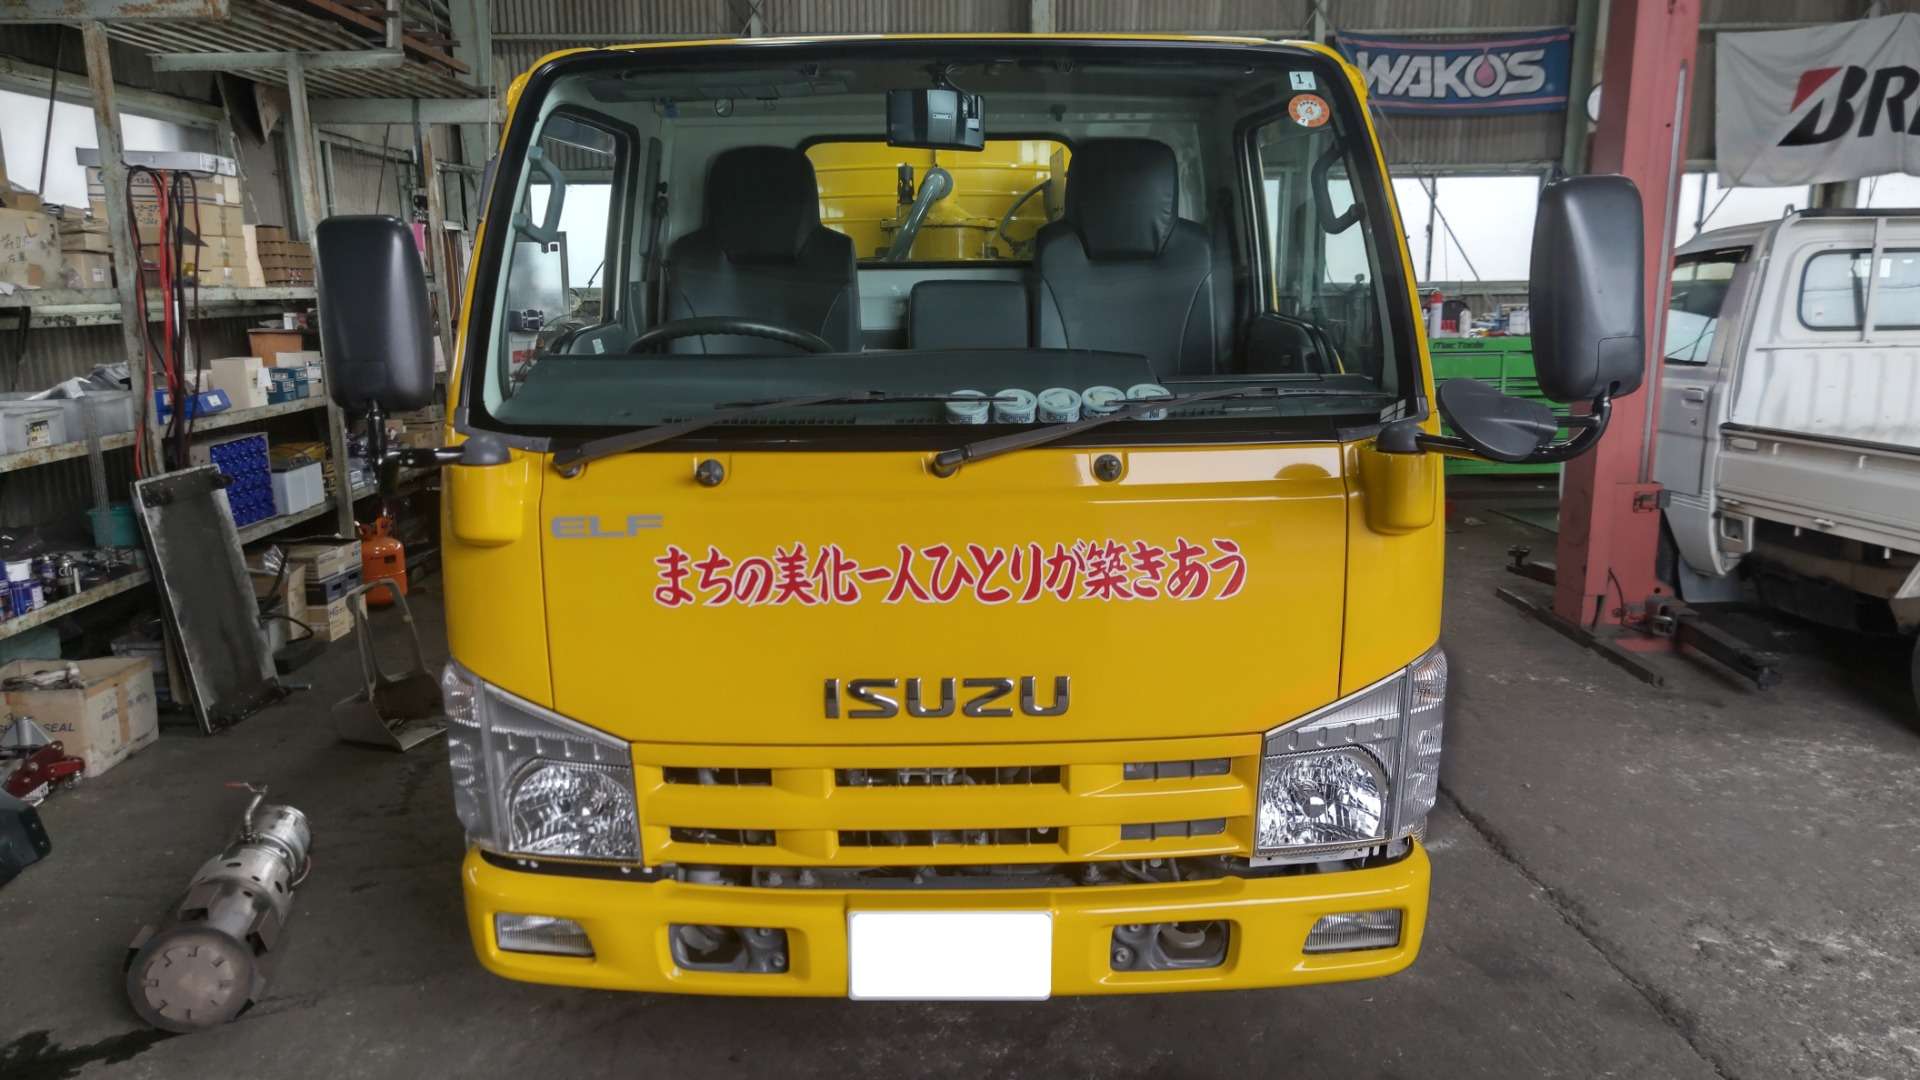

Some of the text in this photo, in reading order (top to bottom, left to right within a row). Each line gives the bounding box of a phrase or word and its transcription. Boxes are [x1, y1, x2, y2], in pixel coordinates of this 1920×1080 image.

[1295, 73, 1304, 84] 1
[1356, 49, 1546, 98] WAKO'S
[1776, 65, 1920, 146] BR
[551, 514, 664, 539] ELF
[824, 675, 1071, 719] ISUZU
[45, 723, 75, 733] SEAL
